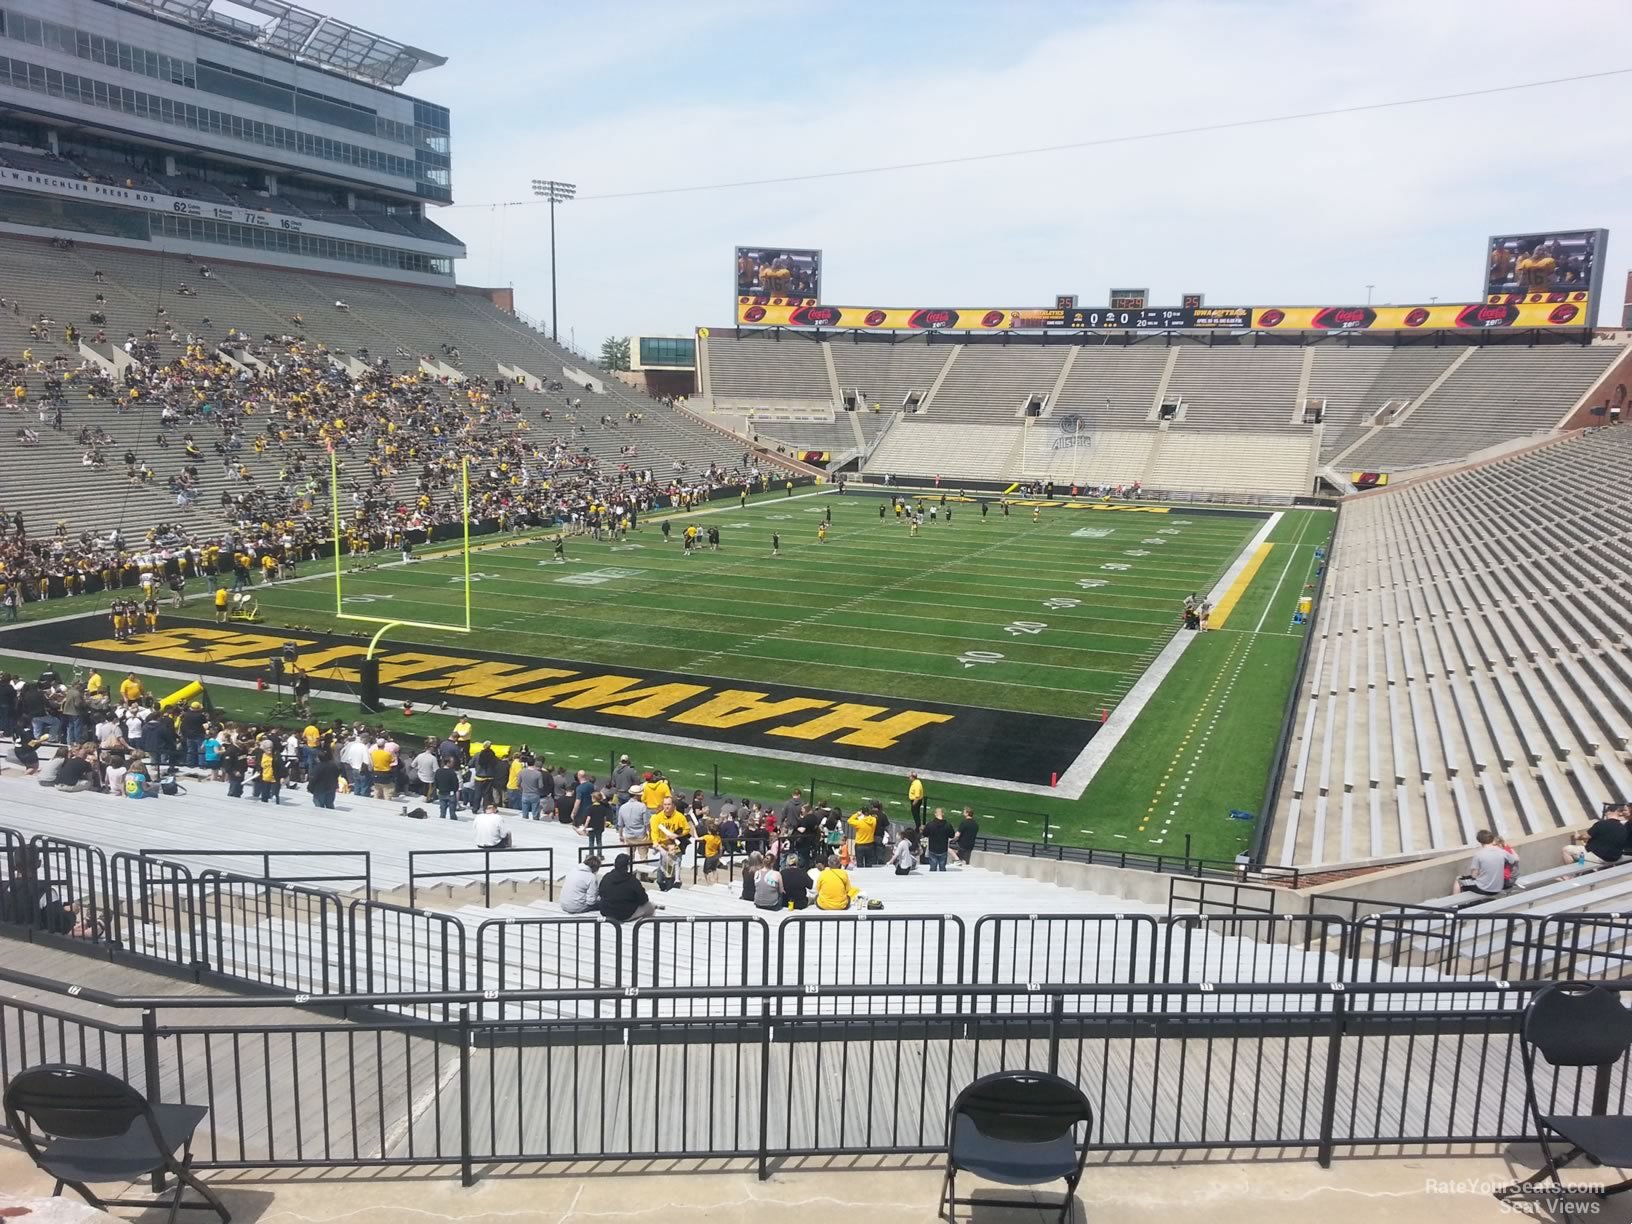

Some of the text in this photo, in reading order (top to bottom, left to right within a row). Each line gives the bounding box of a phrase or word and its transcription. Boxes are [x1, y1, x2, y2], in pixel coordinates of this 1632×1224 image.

[27, 175, 89, 193] BRECHLER
[95, 186, 129, 199] PRESS
[136, 194, 155, 203] BOX
[173, 201, 187, 213] 62
[213, 208, 218, 217] 1
[245, 213, 256, 223] 77
[281, 219, 290, 229] 16
[1058, 298, 1072, 309] 25
[1185, 297, 1199, 309] 25
[1090, 313, 1099, 324] 0
[1120, 313, 1129, 324] 0
[1162, 311, 1173, 319] 10
[1136, 319, 1147, 327] 20
[1052, 434, 1092, 450] Allstate
[1003, 620, 1049, 635] 20
[956, 650, 1006, 665] 10
[70, 626, 954, 750] HAWKEYES
